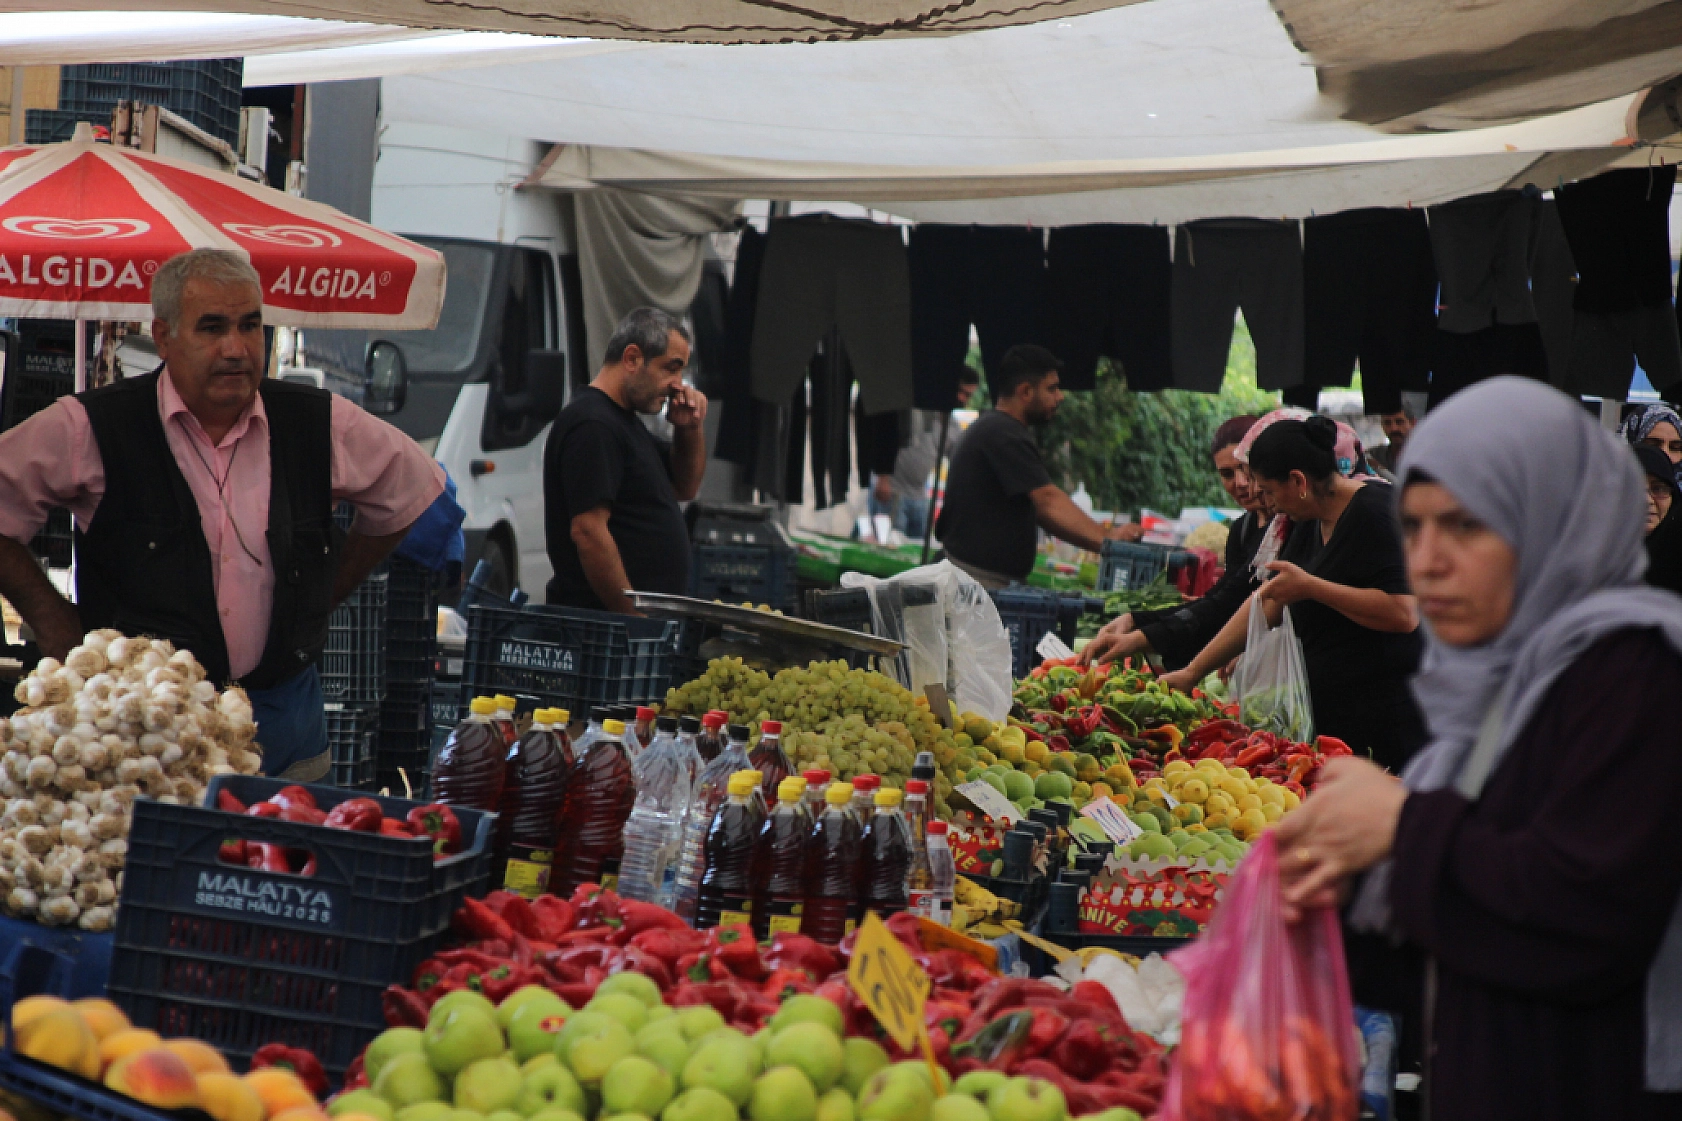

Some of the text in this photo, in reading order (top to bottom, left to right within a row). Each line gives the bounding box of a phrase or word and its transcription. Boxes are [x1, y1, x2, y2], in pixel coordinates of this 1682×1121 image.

[502, 641, 572, 660] MALATYA
[198, 871, 332, 907] MALATYA
[196, 891, 243, 911] SEBZE
